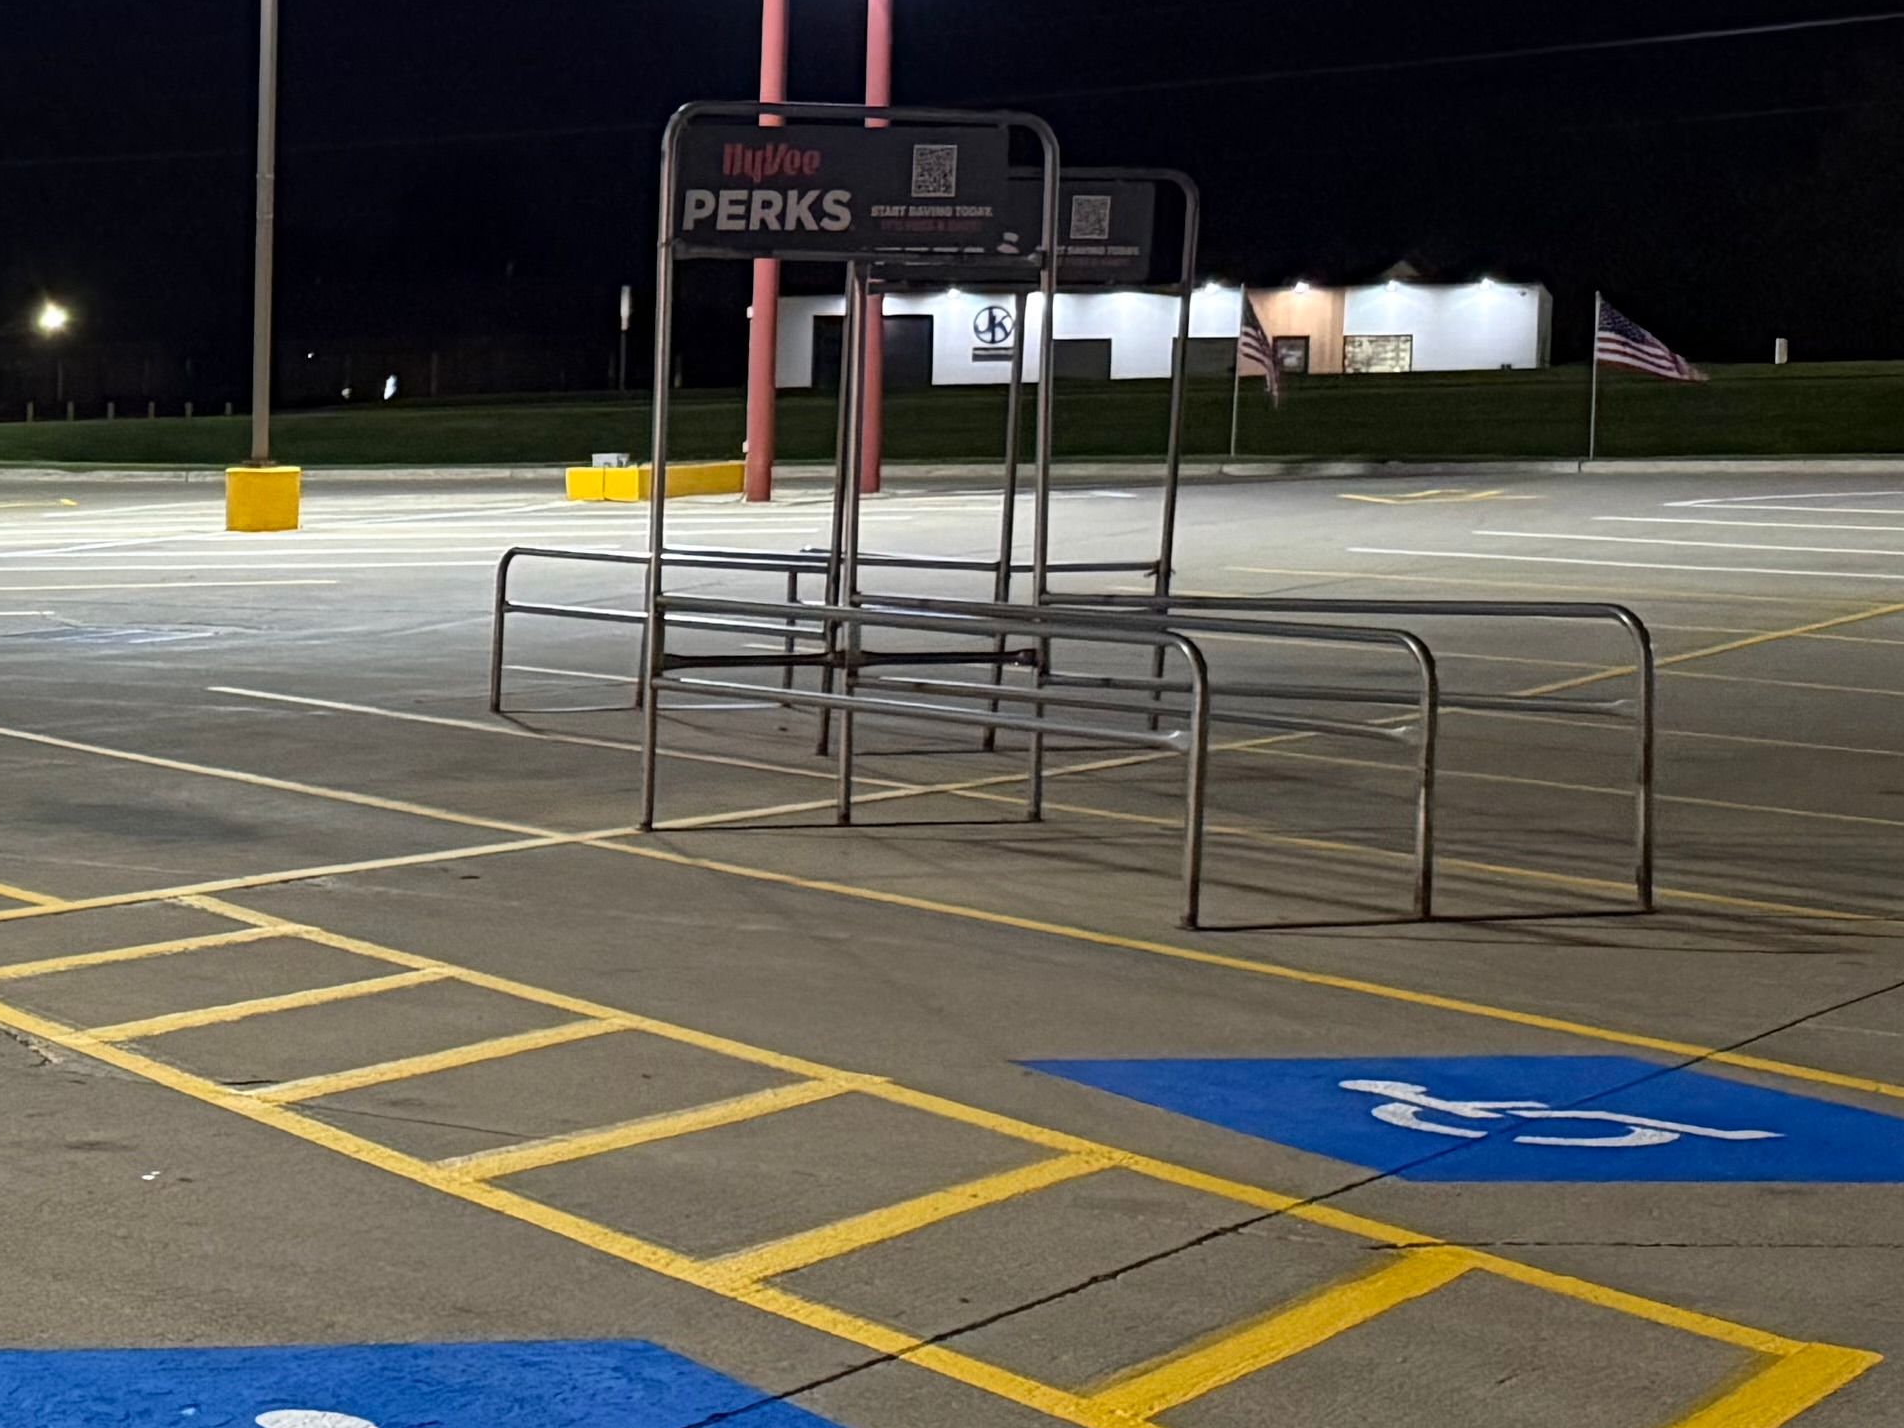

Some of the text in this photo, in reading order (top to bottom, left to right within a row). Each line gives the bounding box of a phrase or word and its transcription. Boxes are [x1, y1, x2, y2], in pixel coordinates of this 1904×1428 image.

[722, 142, 822, 184] HyVee
[682, 189, 853, 232] PERKS
[870, 205, 906, 217] START
[908, 205, 953, 217] SAVING
